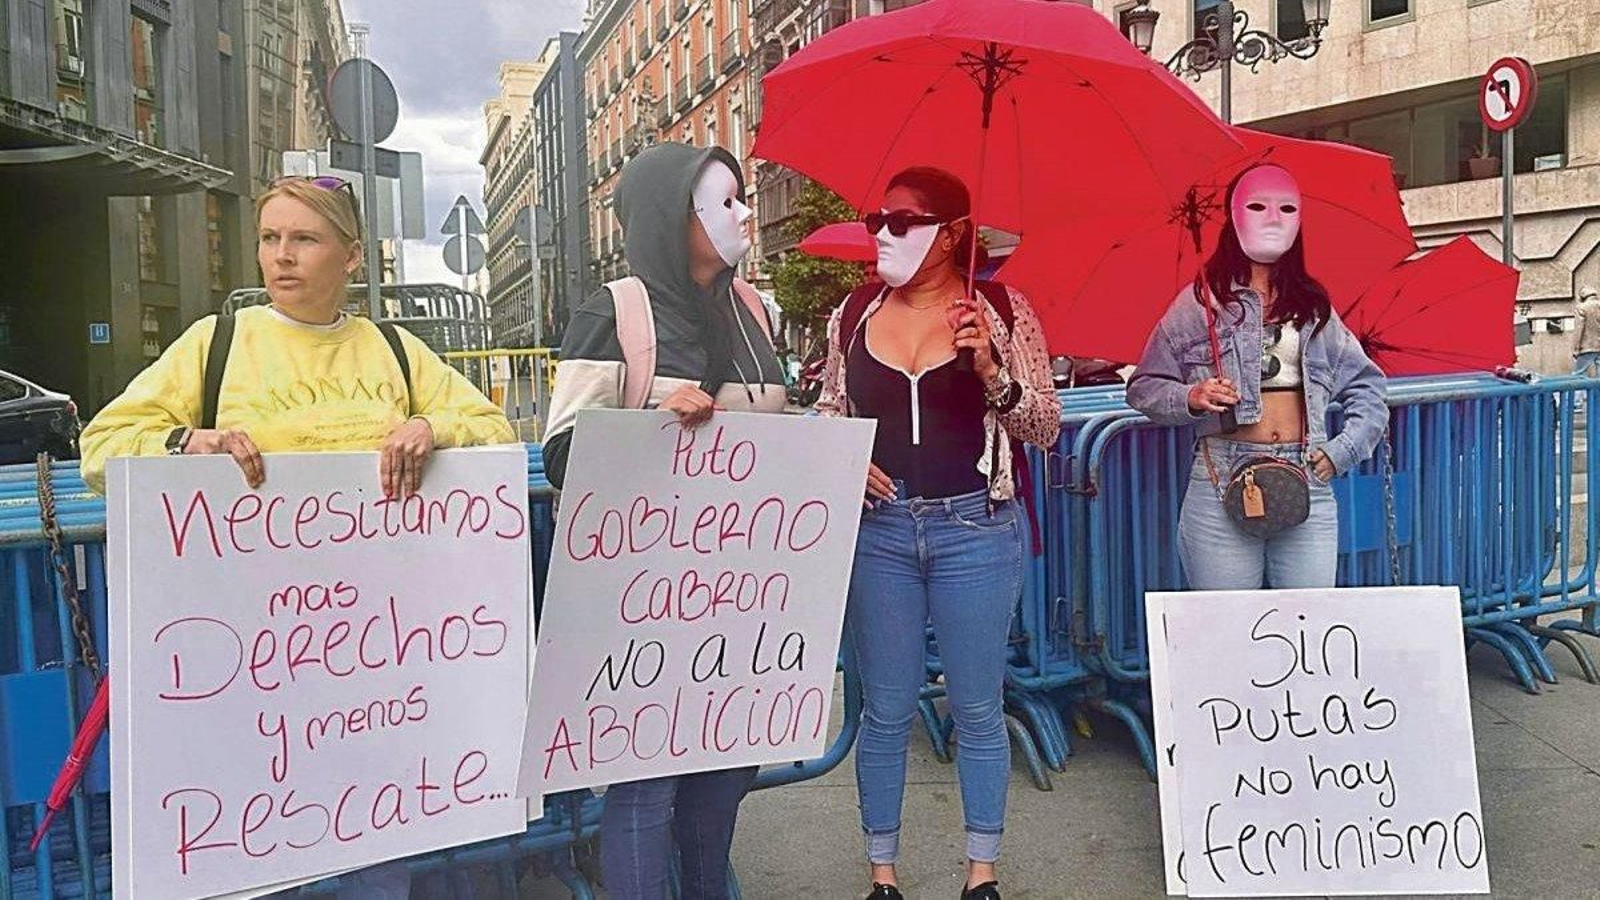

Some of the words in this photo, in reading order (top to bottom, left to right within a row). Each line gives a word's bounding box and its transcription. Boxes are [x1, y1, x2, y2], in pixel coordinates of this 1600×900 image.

[269, 580, 359, 616] mas
[691, 632, 729, 683] a
[751, 621, 806, 675] la
[1251, 608, 1359, 688] Sin
[257, 710, 289, 784] y
[306, 685, 429, 751] menos
[1308, 754, 1396, 808] hay
